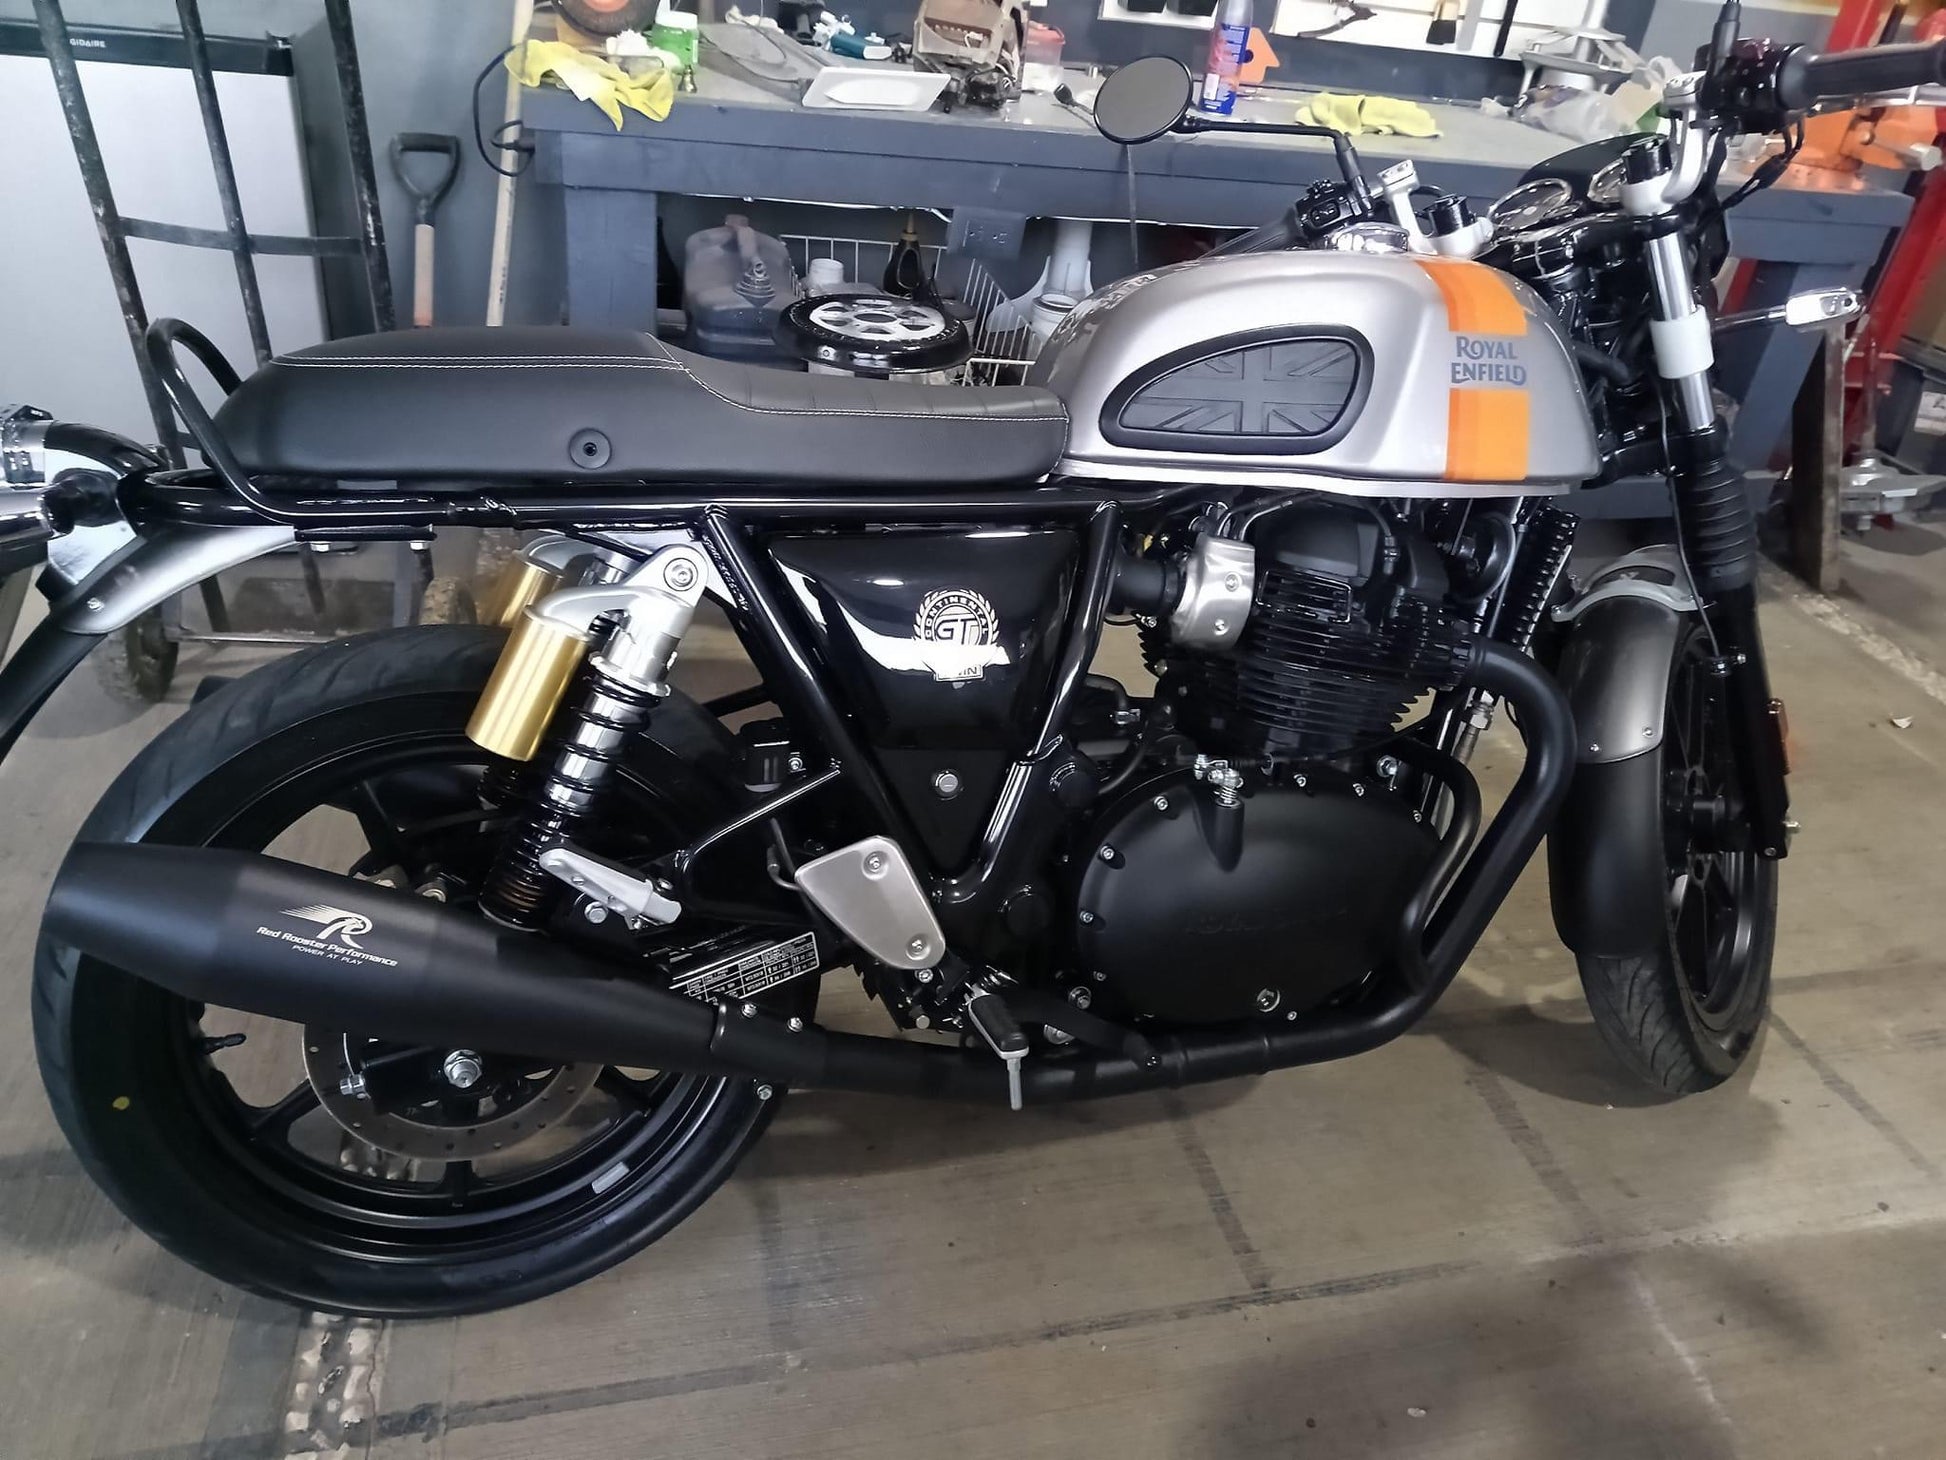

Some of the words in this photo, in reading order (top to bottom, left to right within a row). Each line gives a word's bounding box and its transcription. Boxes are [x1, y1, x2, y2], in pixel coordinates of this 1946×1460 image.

[69, 38, 107, 48] GIDAIRE
[1456, 336, 1518, 360] ROYAL
[1451, 362, 1527, 386] ENFIELD
[924, 596, 989, 639] CONTINENTAL
[935, 617, 979, 645] GT
[256, 926, 282, 938] Red
[281, 932, 328, 950] Rooster
[327, 944, 398, 967] Performance
[292, 945, 325, 957] POWER
[341, 956, 363, 966] PLAY
